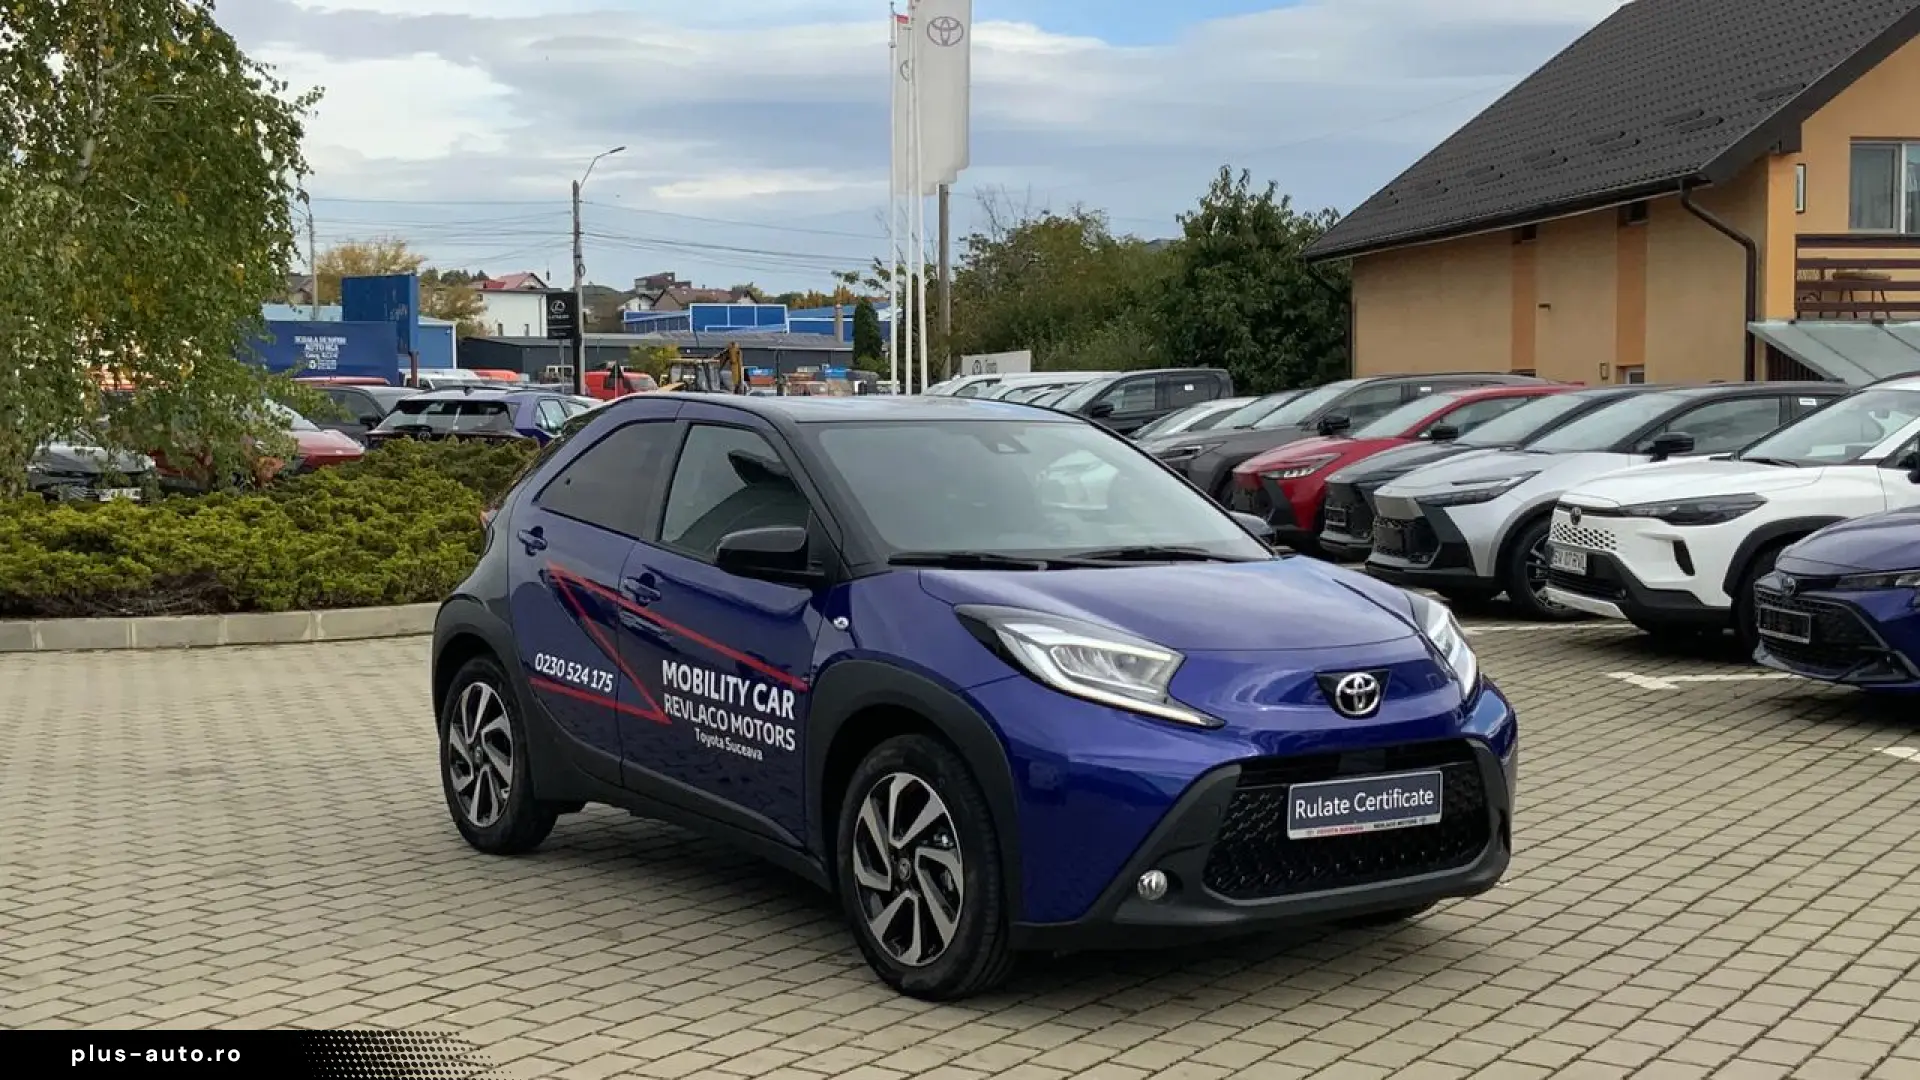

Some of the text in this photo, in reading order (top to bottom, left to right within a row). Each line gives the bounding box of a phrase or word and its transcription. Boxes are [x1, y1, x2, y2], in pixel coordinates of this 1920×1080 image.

[535, 653, 613, 692] 0230 524 175
[662, 659, 795, 720] MOBILITY CAR
[663, 693, 796, 751] REVLACO MOTORS
[695, 727, 763, 760] Toyota Suceava
[1295, 788, 1435, 820] Rulate Certificate
